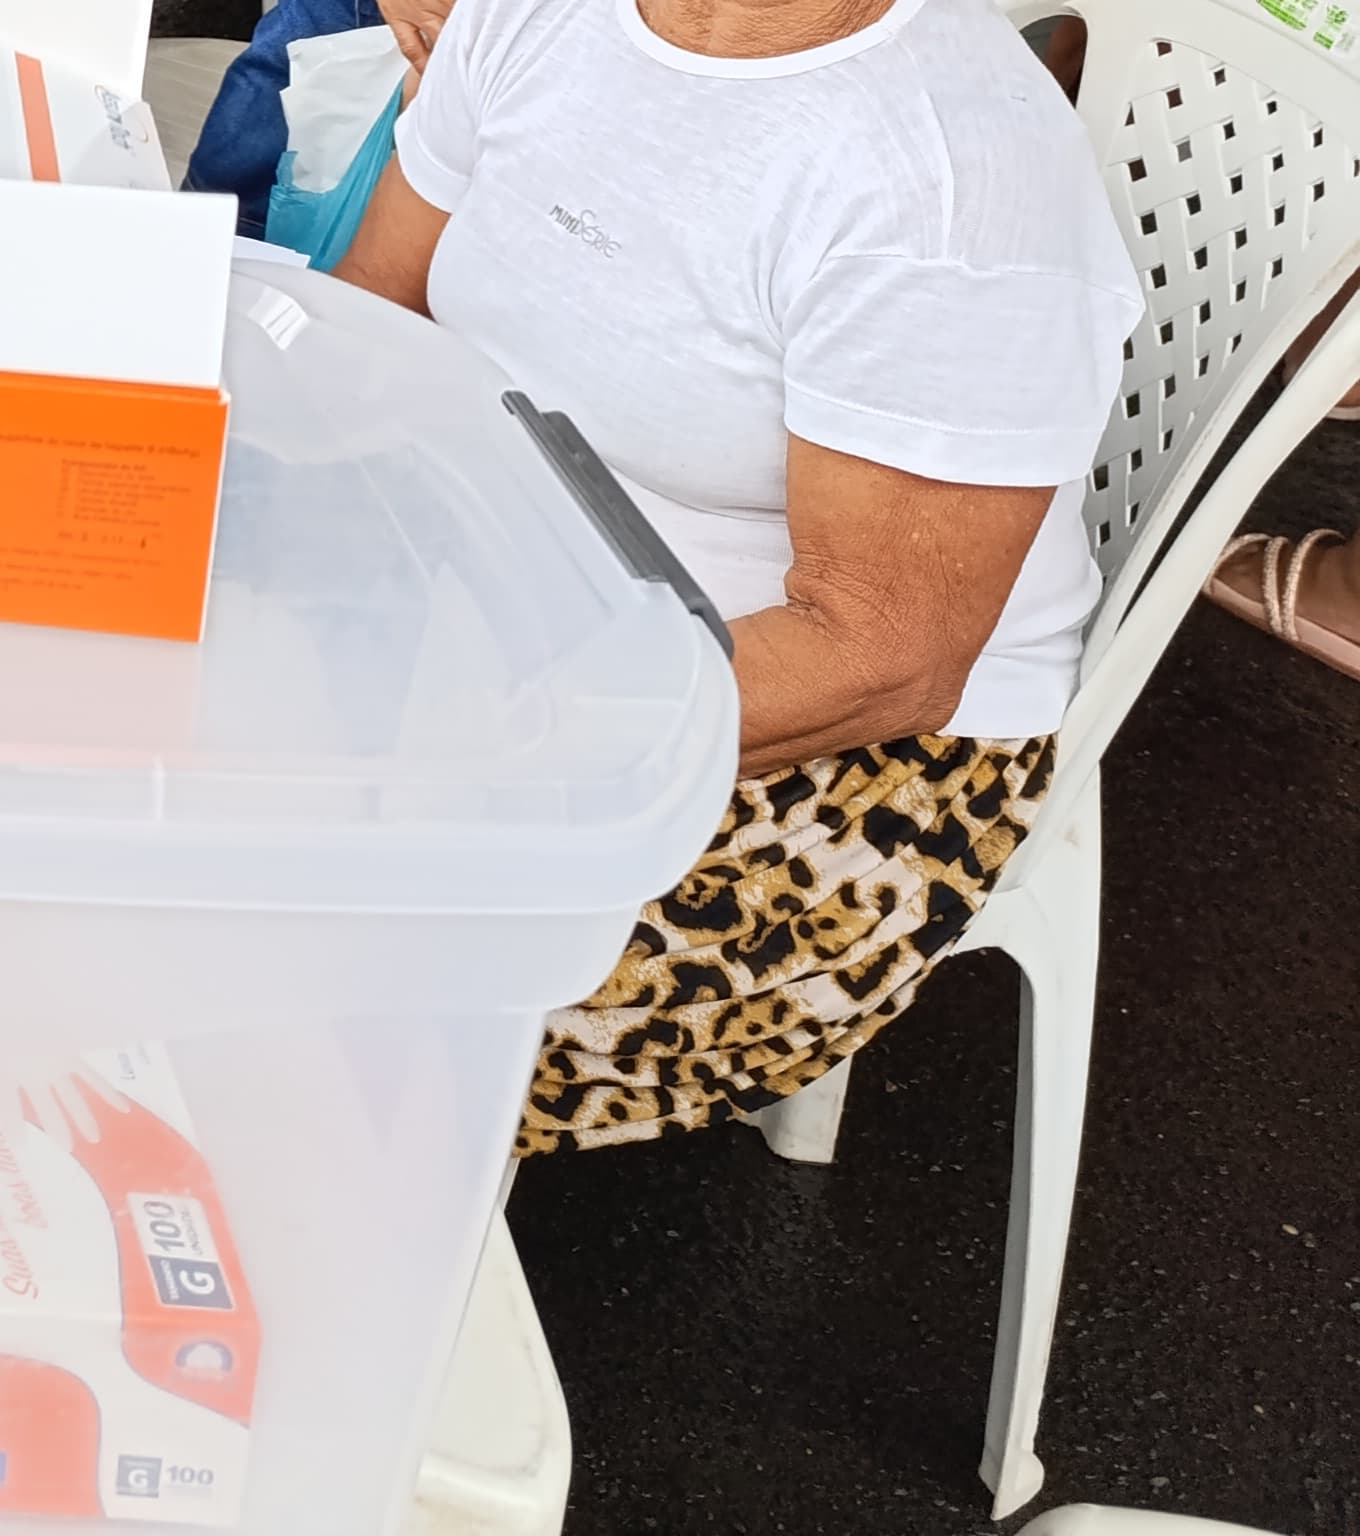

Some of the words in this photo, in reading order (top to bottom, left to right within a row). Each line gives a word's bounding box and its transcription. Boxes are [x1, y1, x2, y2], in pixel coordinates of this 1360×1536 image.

[143, 1201, 186, 1254] 100
[179, 1268, 216, 1295] G
[166, 1466, 215, 1486] 100
